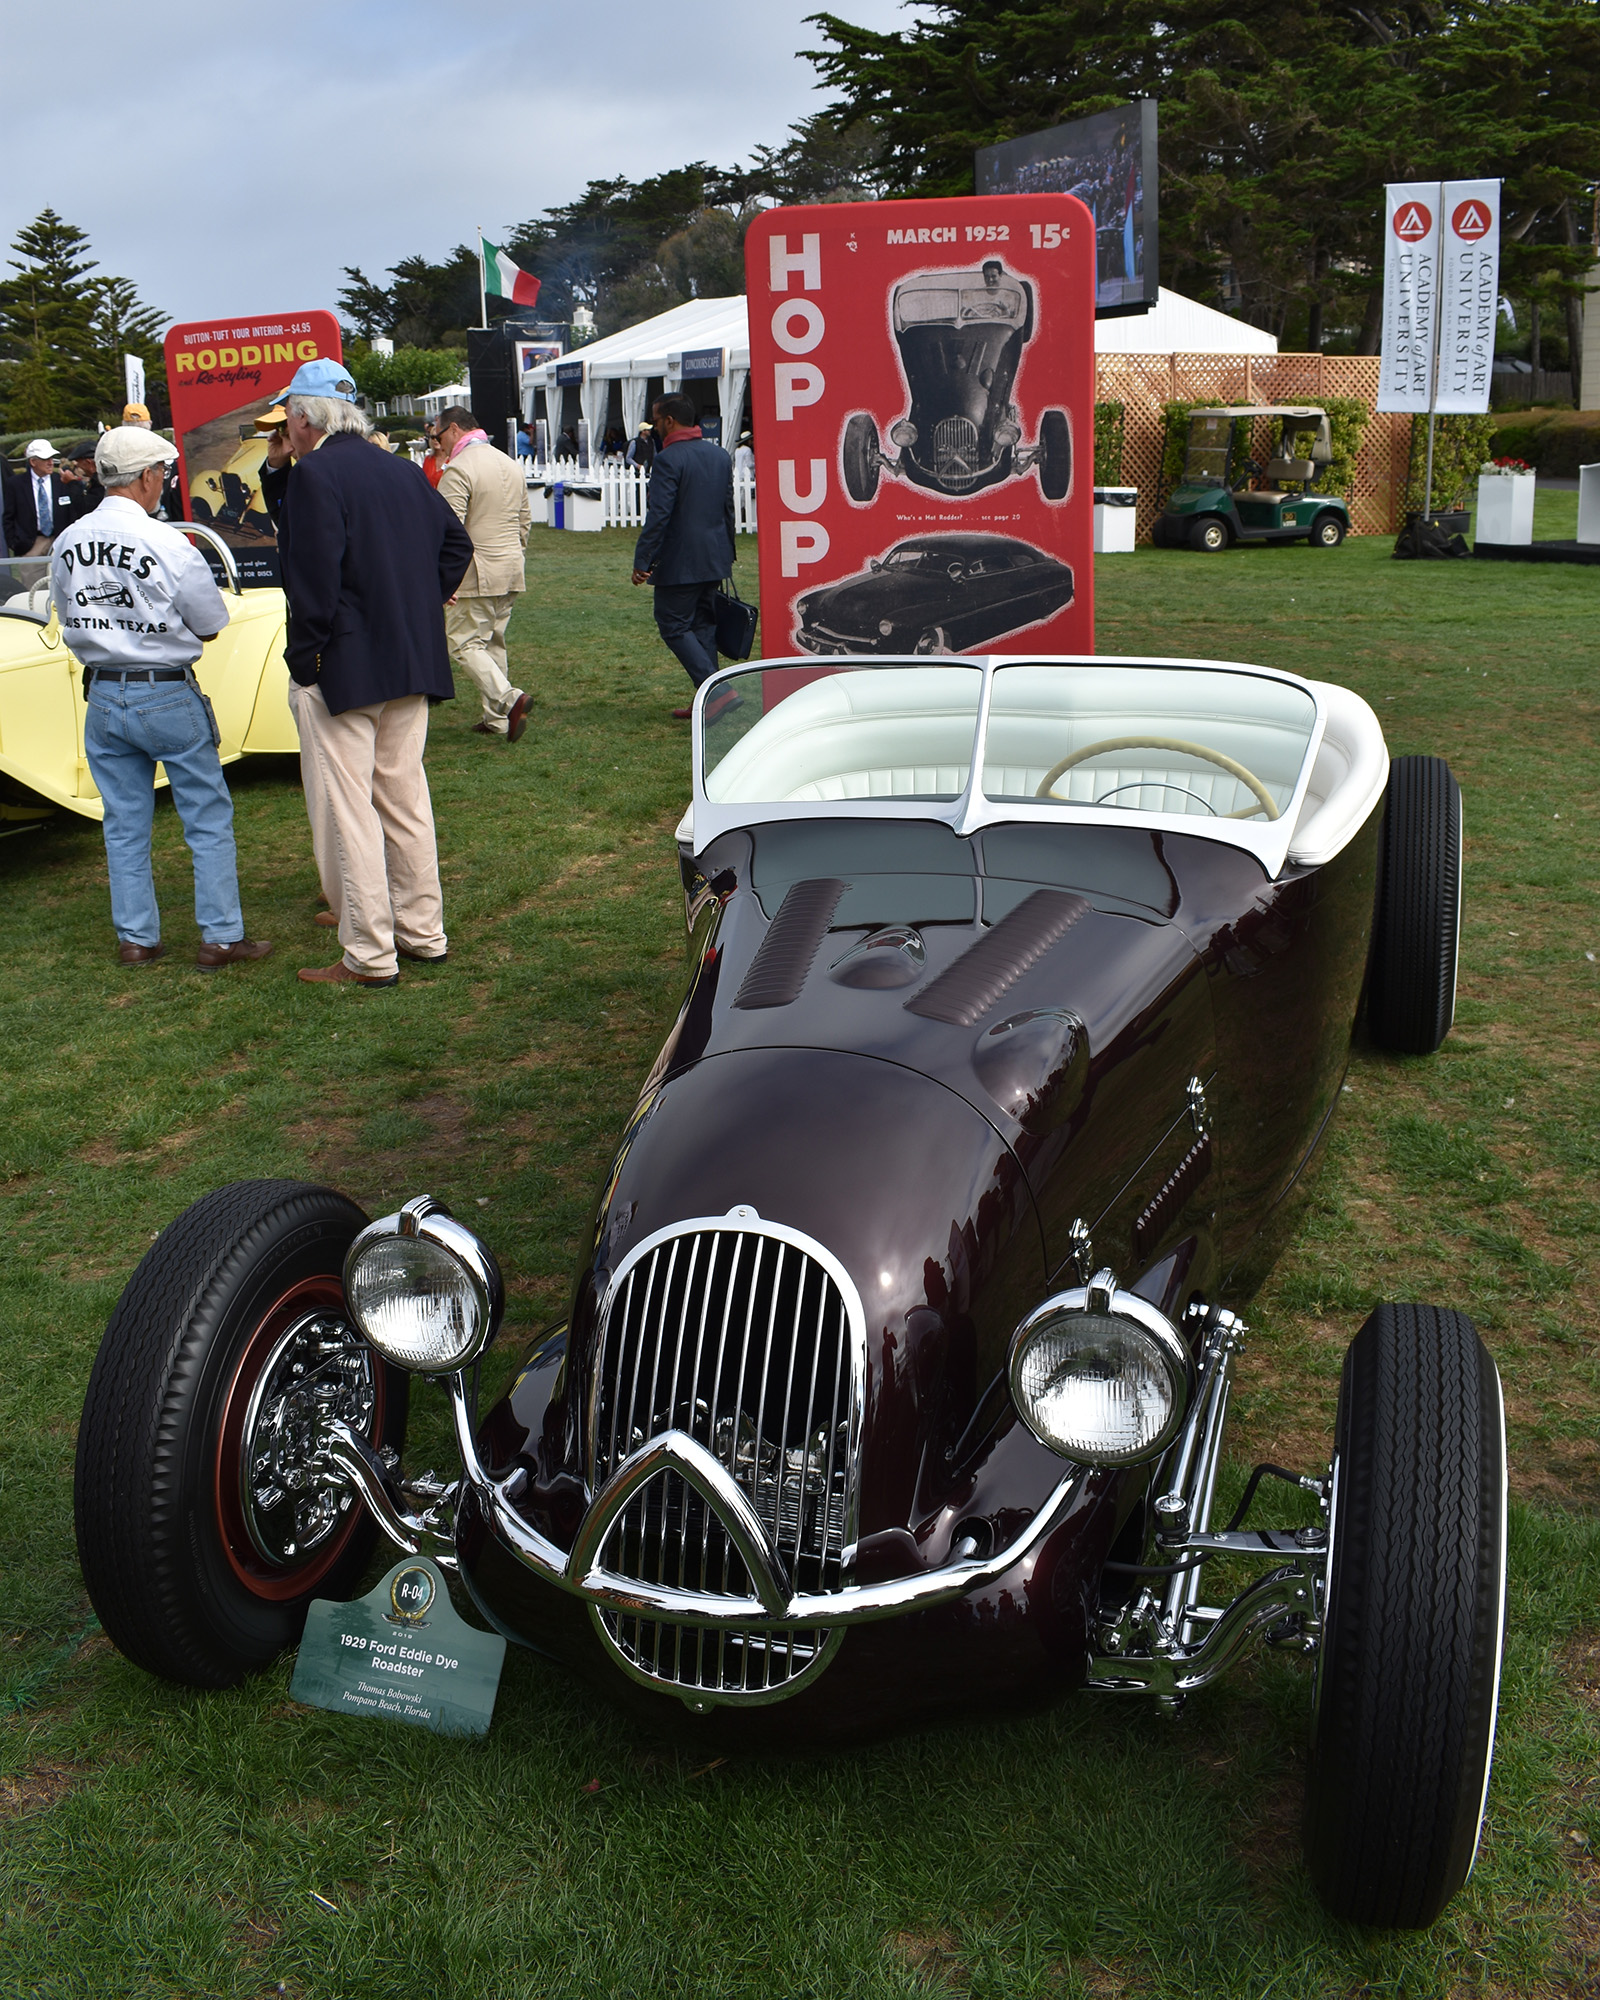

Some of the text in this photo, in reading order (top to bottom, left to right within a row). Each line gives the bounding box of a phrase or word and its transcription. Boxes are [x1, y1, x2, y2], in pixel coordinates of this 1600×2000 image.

[887, 227, 957, 244] MARCH
[965, 225, 1010, 242] 1952
[184, 329, 229, 345] BUTTON-TUFT
[232, 328, 250, 338] YOUR
[1394, 254, 1413, 395] UNIVERSITY
[1411, 254, 1432, 396] ACADEMY of ART
[1453, 252, 1473, 395] UNIVERSITY
[1472, 252, 1493, 395] ACADEMY of ART
[175, 340, 318, 373] RODDING
[196, 367, 262, 387] Re-styling
[769, 233, 831, 578] HOP UP
[60, 541, 158, 579] DUKES
[116, 619, 167, 634] TEXAS
[401, 1583, 424, 1600] R-04
[340, 1634, 459, 1670] 1929 Ford Eddie Dye
[371, 1656, 424, 1677] Roadster
[342, 1691, 431, 1719] Pompano Beach, Florida
[357, 1681, 422, 1704] Thomas Bobowski
